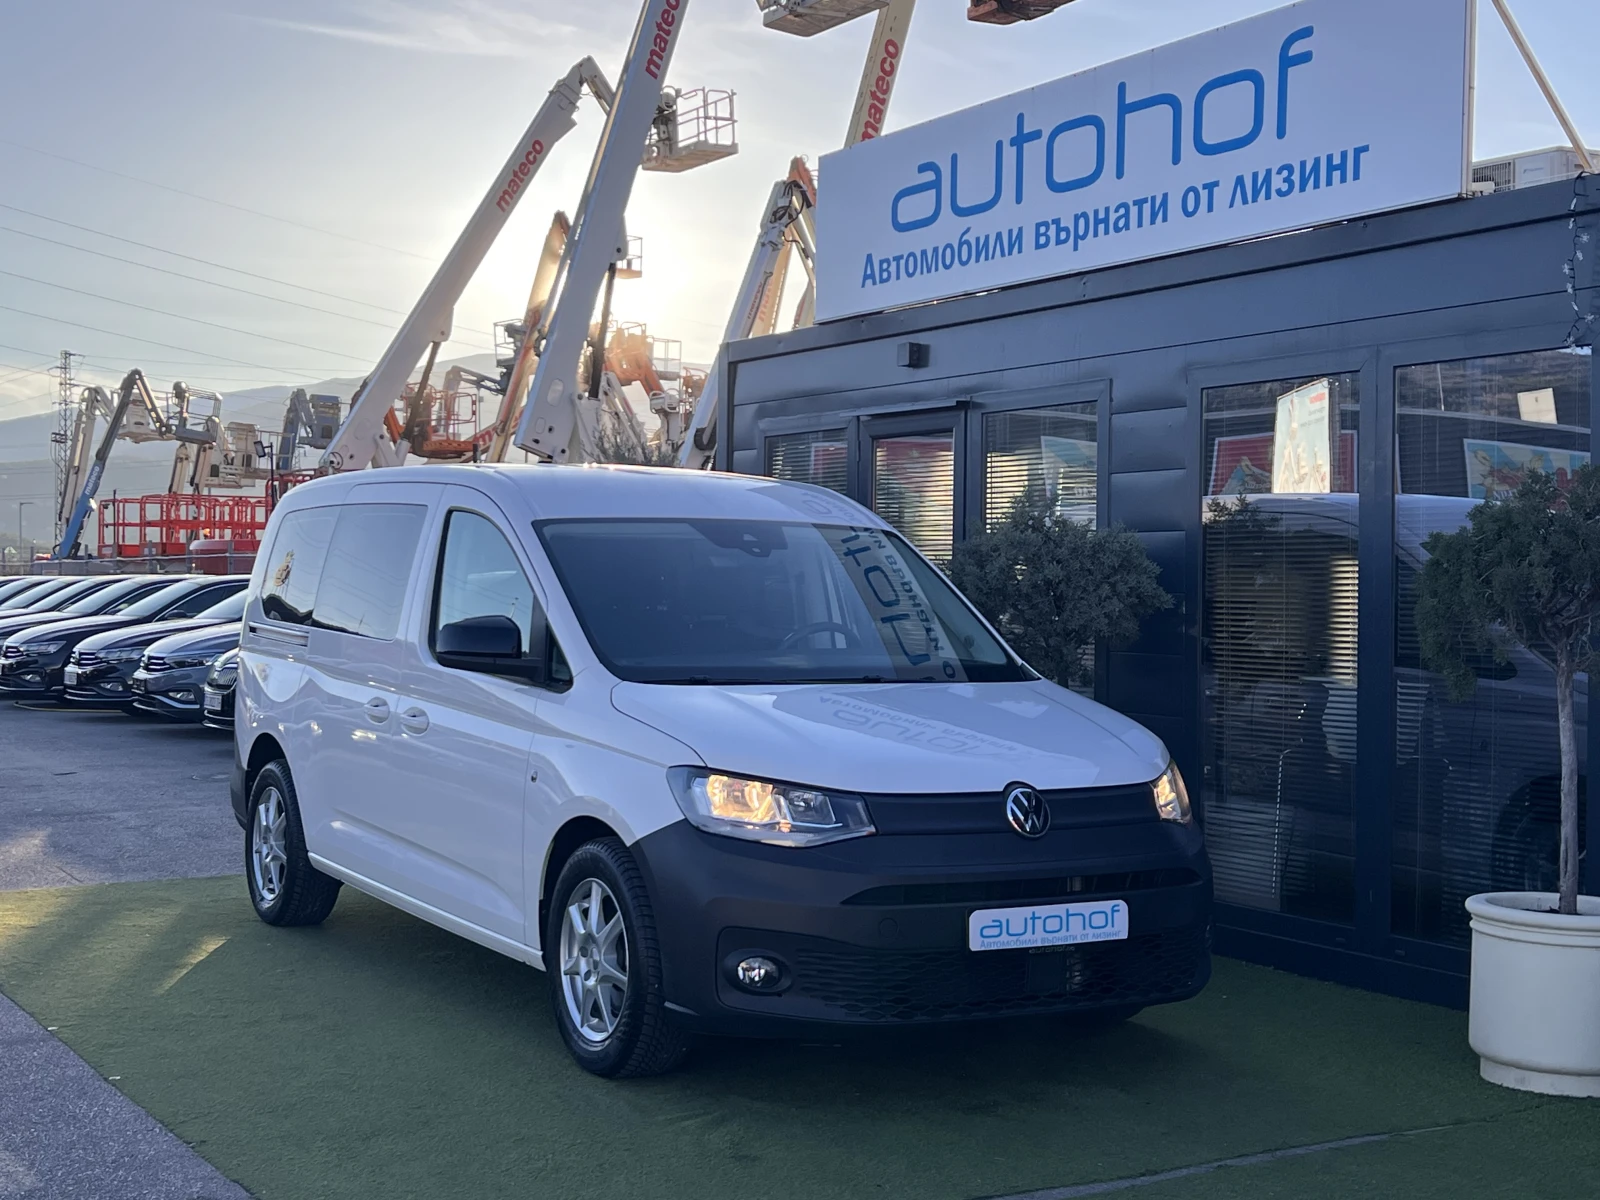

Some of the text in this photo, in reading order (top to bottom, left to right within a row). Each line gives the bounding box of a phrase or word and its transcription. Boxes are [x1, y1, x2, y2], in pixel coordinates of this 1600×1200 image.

[645, 0, 680, 80] matec
[891, 25, 1315, 233] autohof
[495, 139, 544, 213] mateco
[861, 143, 1370, 289] Автомобили върнати от лизинг
[84, 465, 100, 496] mateco
[979, 904, 1120, 939] autohof
[980, 937, 1038, 950] Автомобили
[1080, 932, 1090, 941] от
